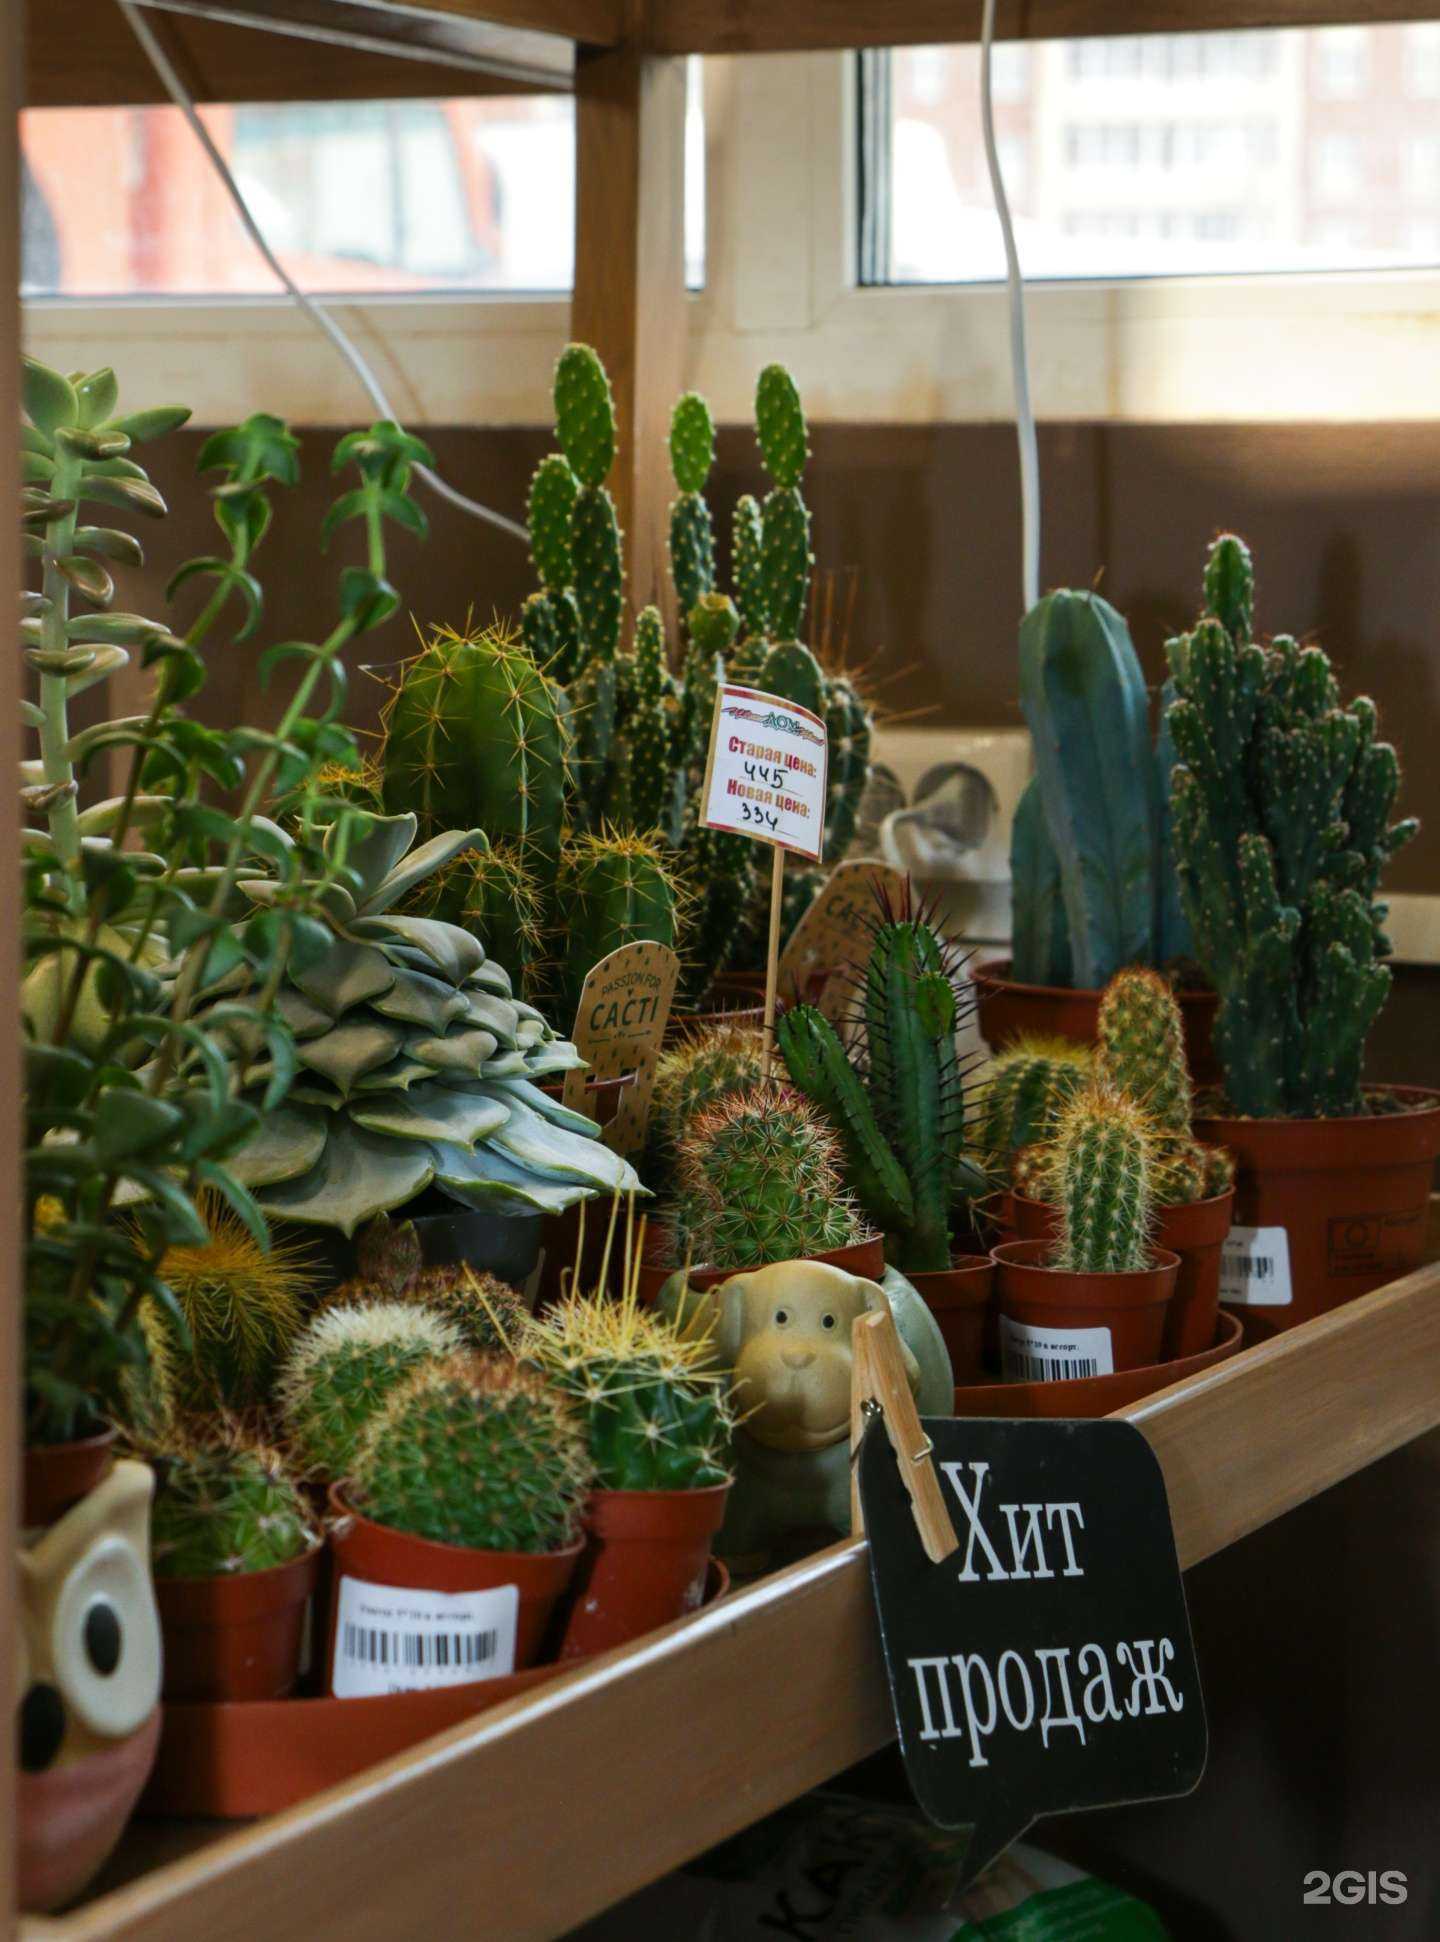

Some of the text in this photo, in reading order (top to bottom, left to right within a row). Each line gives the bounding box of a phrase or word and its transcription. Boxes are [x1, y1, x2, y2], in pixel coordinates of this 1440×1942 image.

[728, 735, 817, 779] Старая цена:
[744, 761, 789, 788] 445
[727, 779, 811, 819] Новая цена:
[741, 802, 778, 831] 334
[601, 972, 643, 995] PASSION
[590, 995, 660, 1031] CACTI
[940, 1462, 1085, 1582] Хит
[908, 1638, 1184, 1767] продаж
